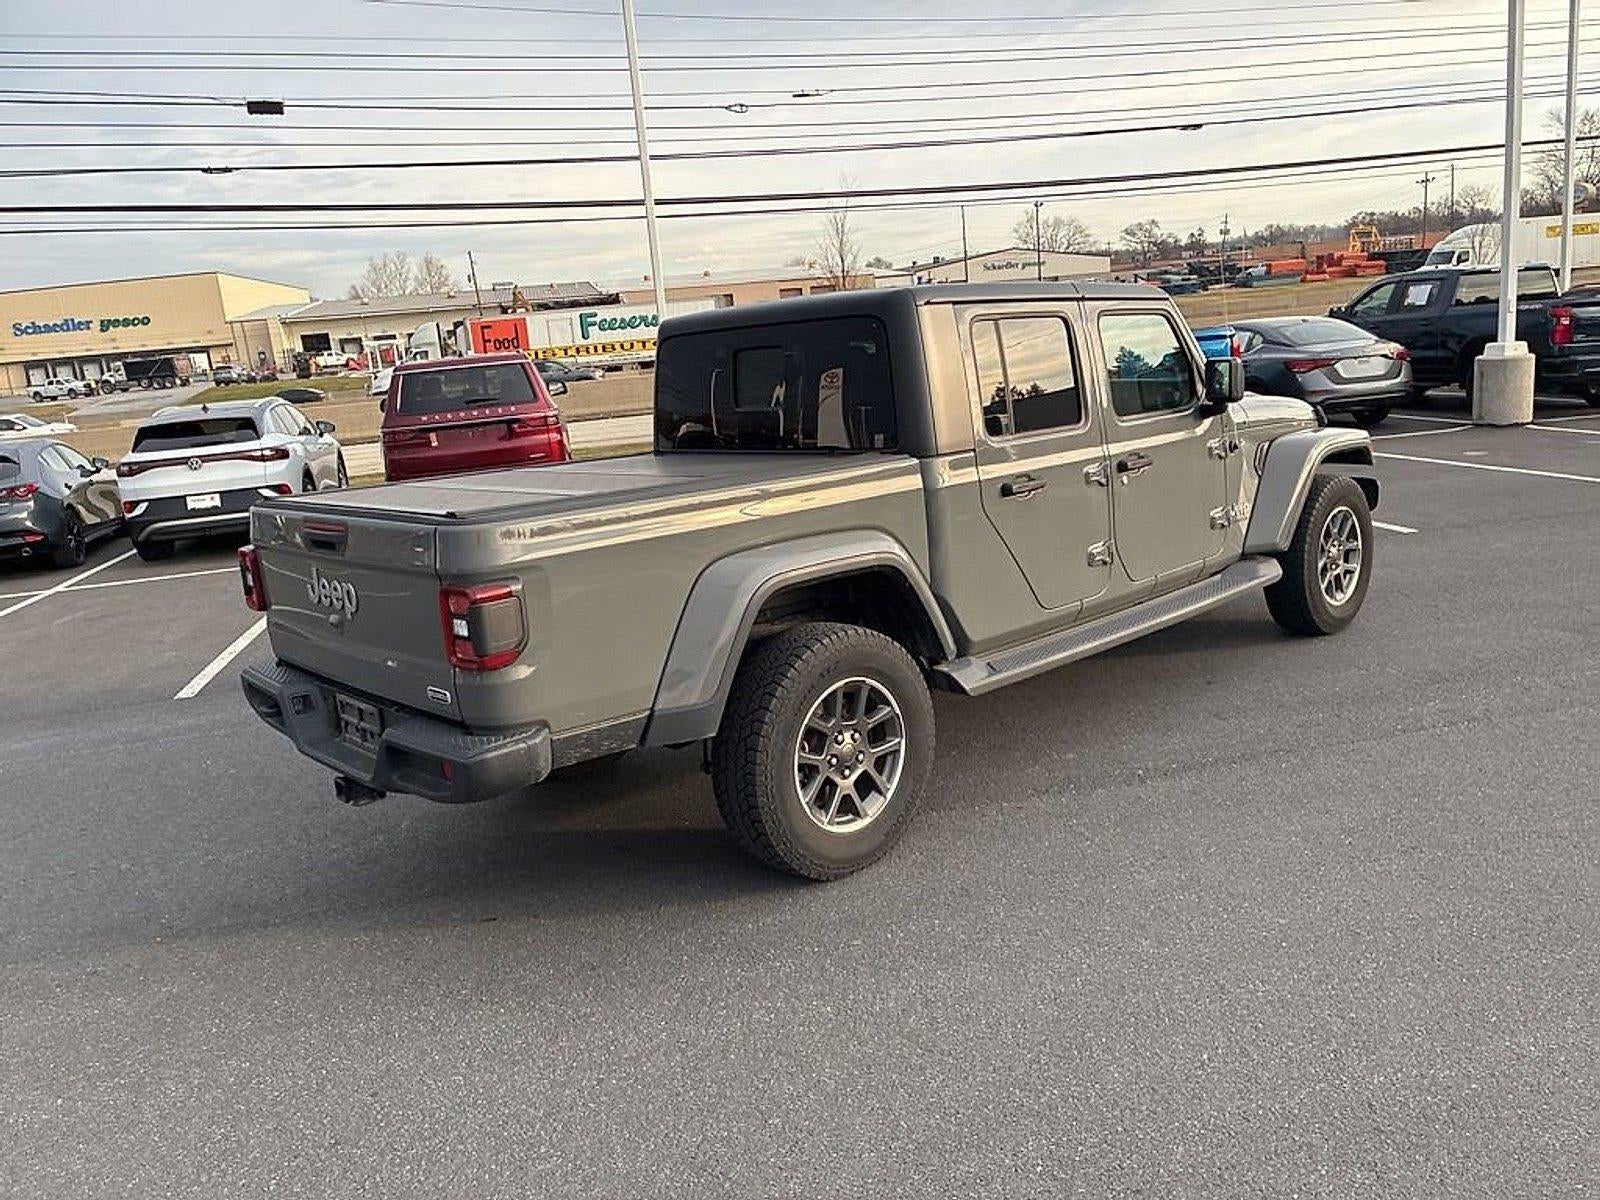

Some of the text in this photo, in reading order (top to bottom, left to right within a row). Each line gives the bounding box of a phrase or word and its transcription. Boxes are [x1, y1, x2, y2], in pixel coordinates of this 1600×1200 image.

[12, 317, 94, 337] Schaedler
[480, 323, 520, 355] Food
[578, 310, 660, 340] Feesers
[306, 567, 359, 621] Jeep
